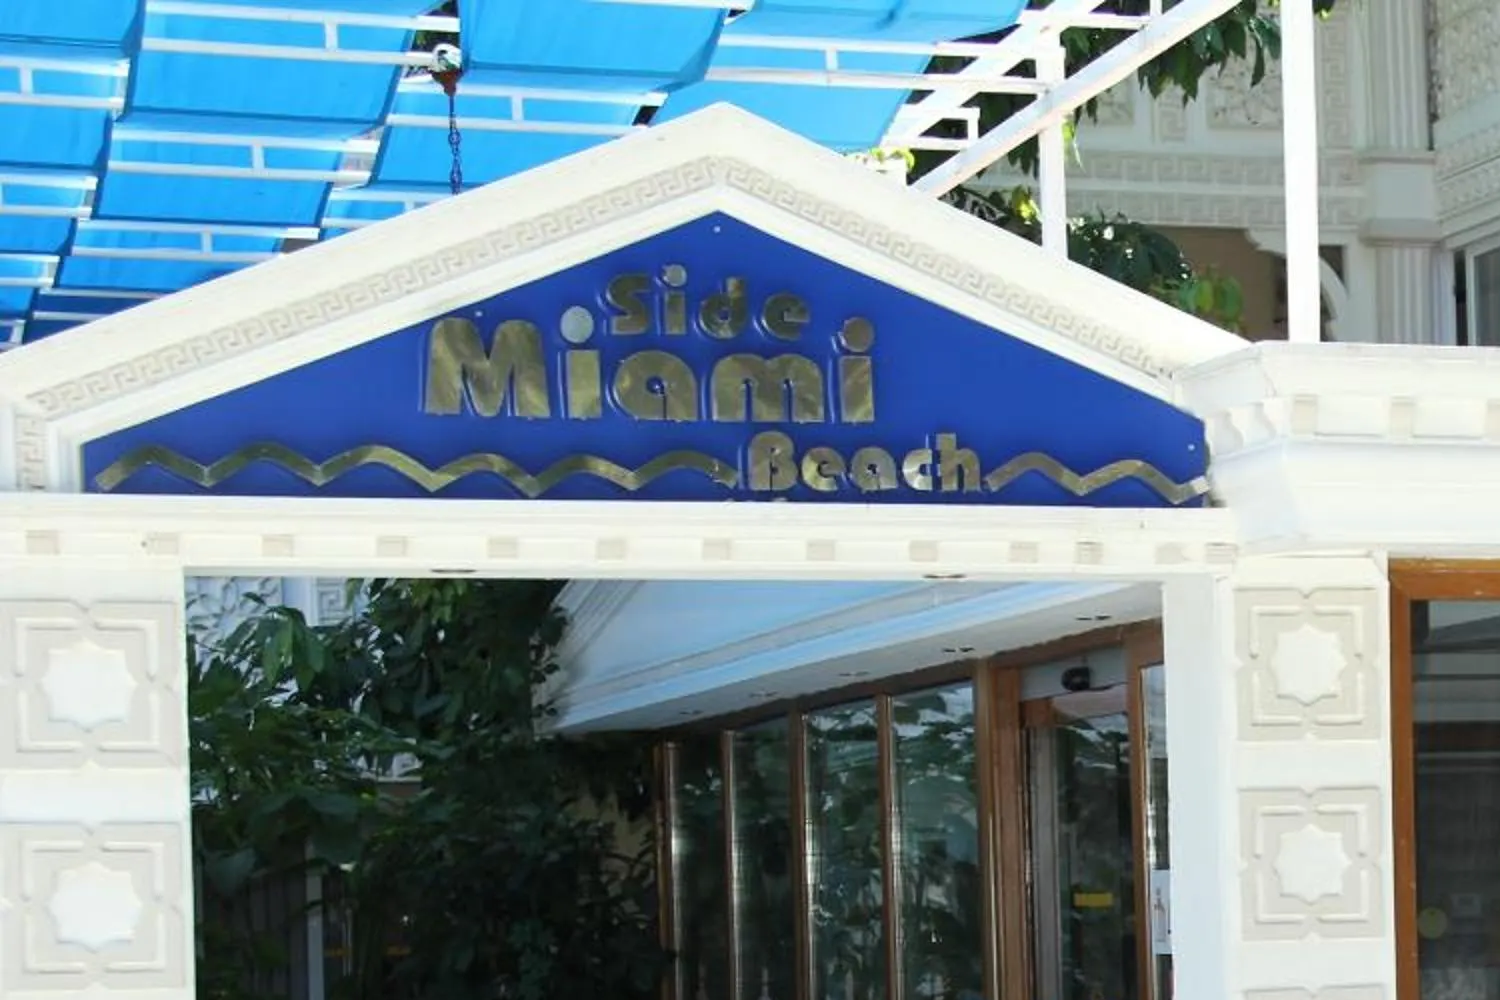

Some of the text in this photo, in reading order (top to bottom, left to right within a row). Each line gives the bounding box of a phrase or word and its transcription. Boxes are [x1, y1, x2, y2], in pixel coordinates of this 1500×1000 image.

[605, 263, 811, 341] Side
[421, 304, 876, 424] Miami
[746, 429, 985, 494] Beach
